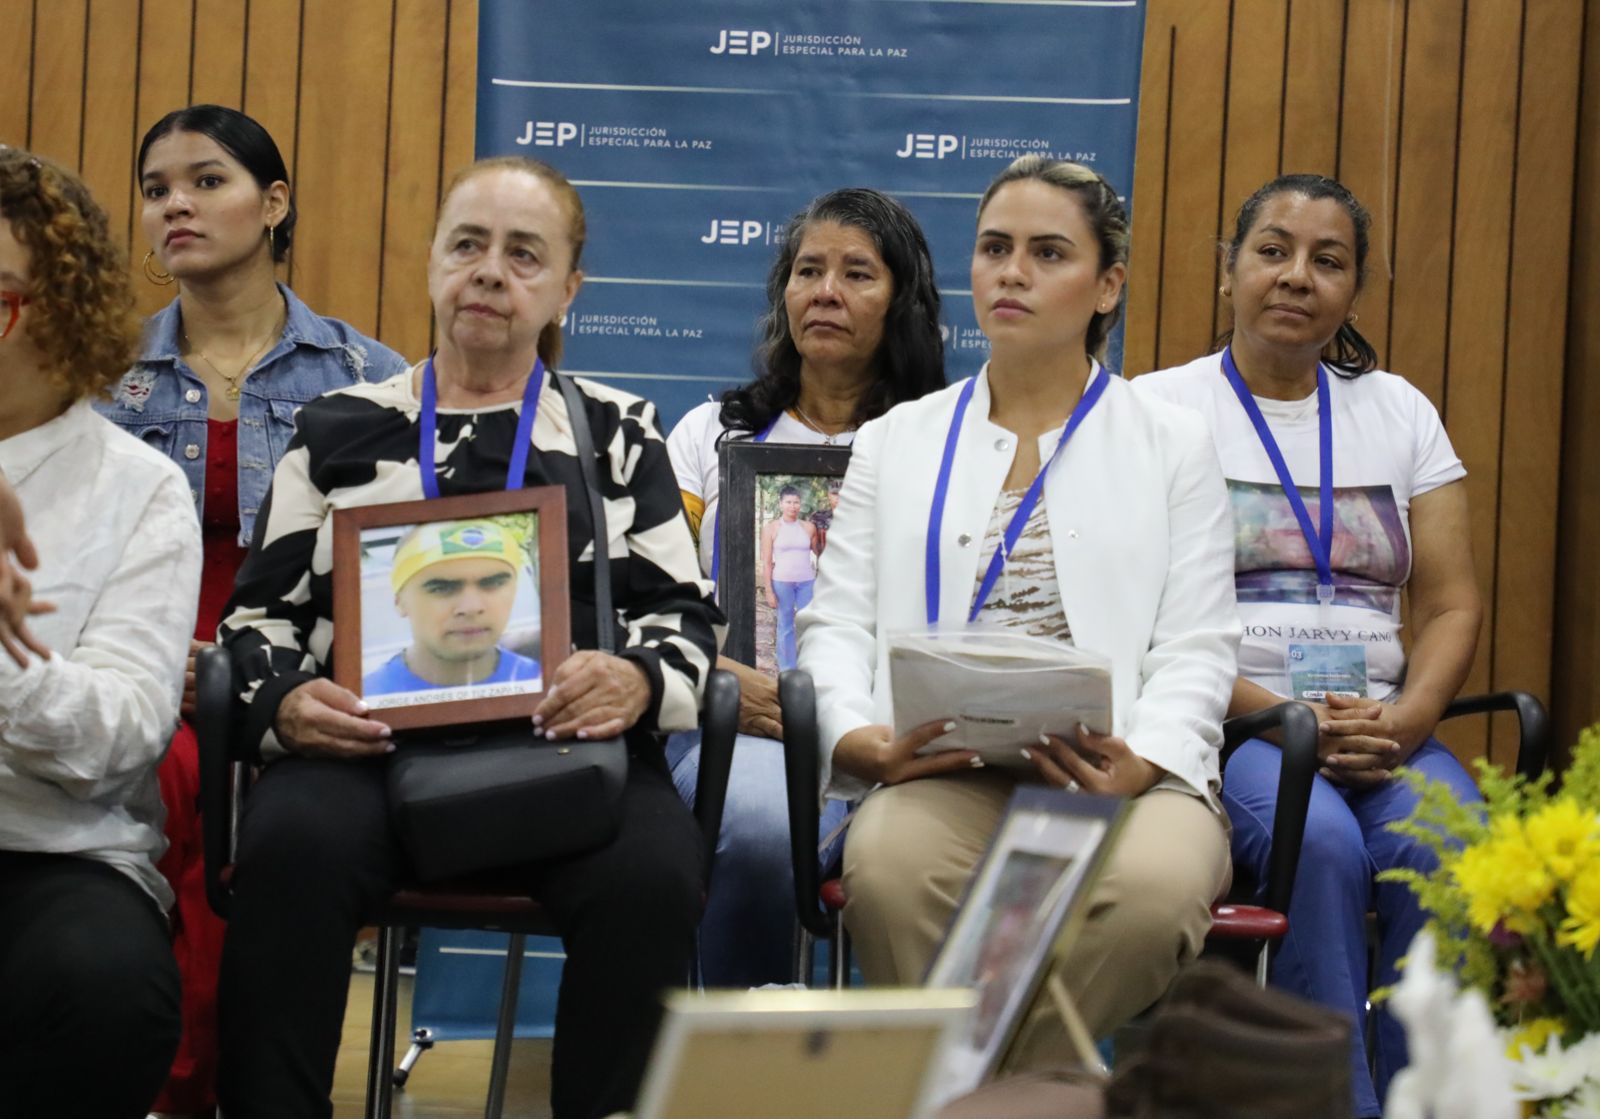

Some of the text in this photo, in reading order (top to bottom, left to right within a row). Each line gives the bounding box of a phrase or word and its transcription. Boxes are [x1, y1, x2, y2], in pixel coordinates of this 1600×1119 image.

[710, 30, 771, 55] JEP
[783, 35, 861, 45] JURISDICCIÓN
[783, 46, 908, 57] ESPECIAL PARA LA PAZ
[516, 121, 577, 147] JEP
[589, 126, 667, 136] JURISDICCIÓN
[588, 137, 712, 149] ESPECIAL PARA LA PAZ
[896, 133, 958, 159] JEP
[970, 138, 1049, 149] JURISDICCIÓN
[970, 149, 1021, 158] ESPECIAL
[1058, 152, 1072, 161] LA
[1076, 152, 1097, 161] PAZ
[701, 219, 763, 245] JEP
[579, 314, 657, 325] JURISDICCIÓN
[579, 325, 703, 338] ESPECIAL PARA LA PAZ
[1289, 626, 1351, 640] JARVY
